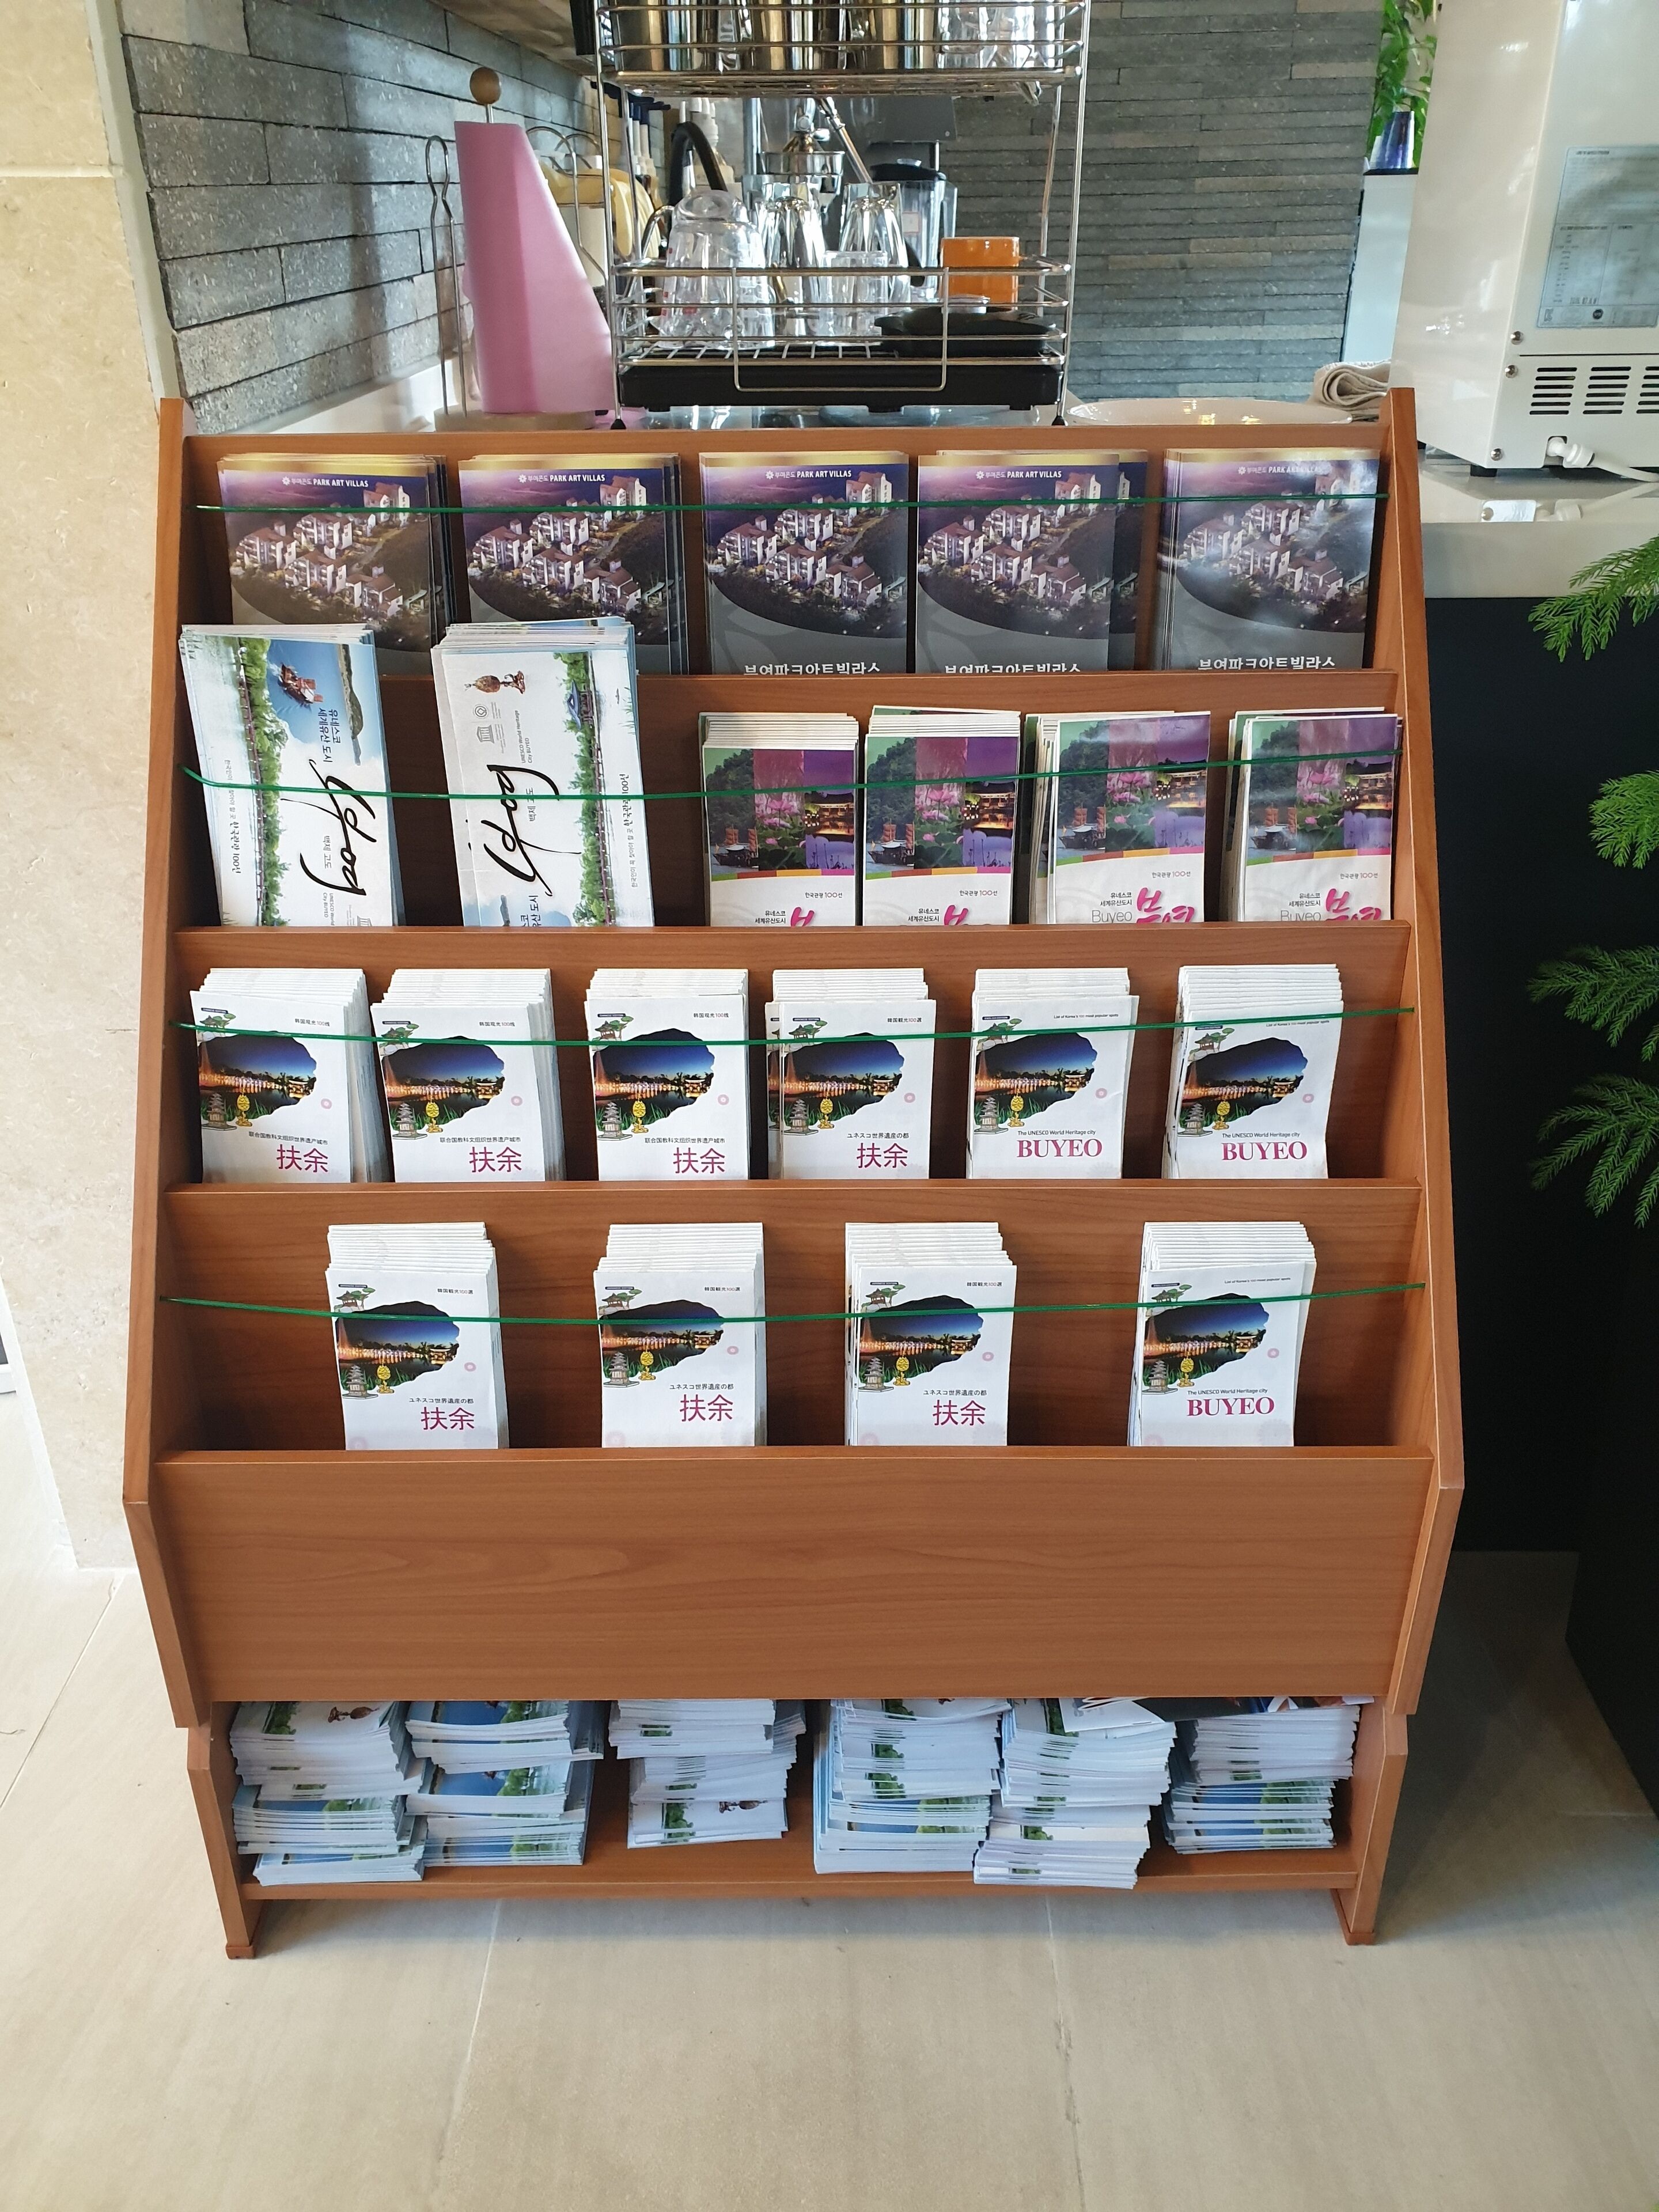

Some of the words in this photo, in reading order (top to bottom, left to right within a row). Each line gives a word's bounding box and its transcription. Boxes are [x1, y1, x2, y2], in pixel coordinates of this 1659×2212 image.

[318, 708, 331, 743] 세계유산
[329, 709, 341, 744] 유네스코
[323, 745, 334, 763] 도시
[619, 774, 629, 794] 100선
[527, 805, 536, 822] 백제
[230, 821, 240, 850] 한국관광
[323, 835, 332, 851] 백제
[232, 853, 241, 873] 100선
[324, 853, 333, 869] 고도
[529, 895, 539, 912] 도시
[1092, 910, 1132, 923] Buyeo
[276, 1143, 328, 1173] 扶余
[857, 1142, 908, 1169] 扶余
[1017, 1138, 1103, 1158] BUYEO
[1221, 1141, 1307, 1161] BUYEO
[469, 1146, 522, 1173] 扶余
[673, 1147, 725, 1174] 扶余
[680, 1394, 733, 1422] 扶余
[933, 1399, 986, 1426] 扶余
[1187, 1396, 1275, 1416] BUYEO
[421, 1406, 475, 1430] 扶余
